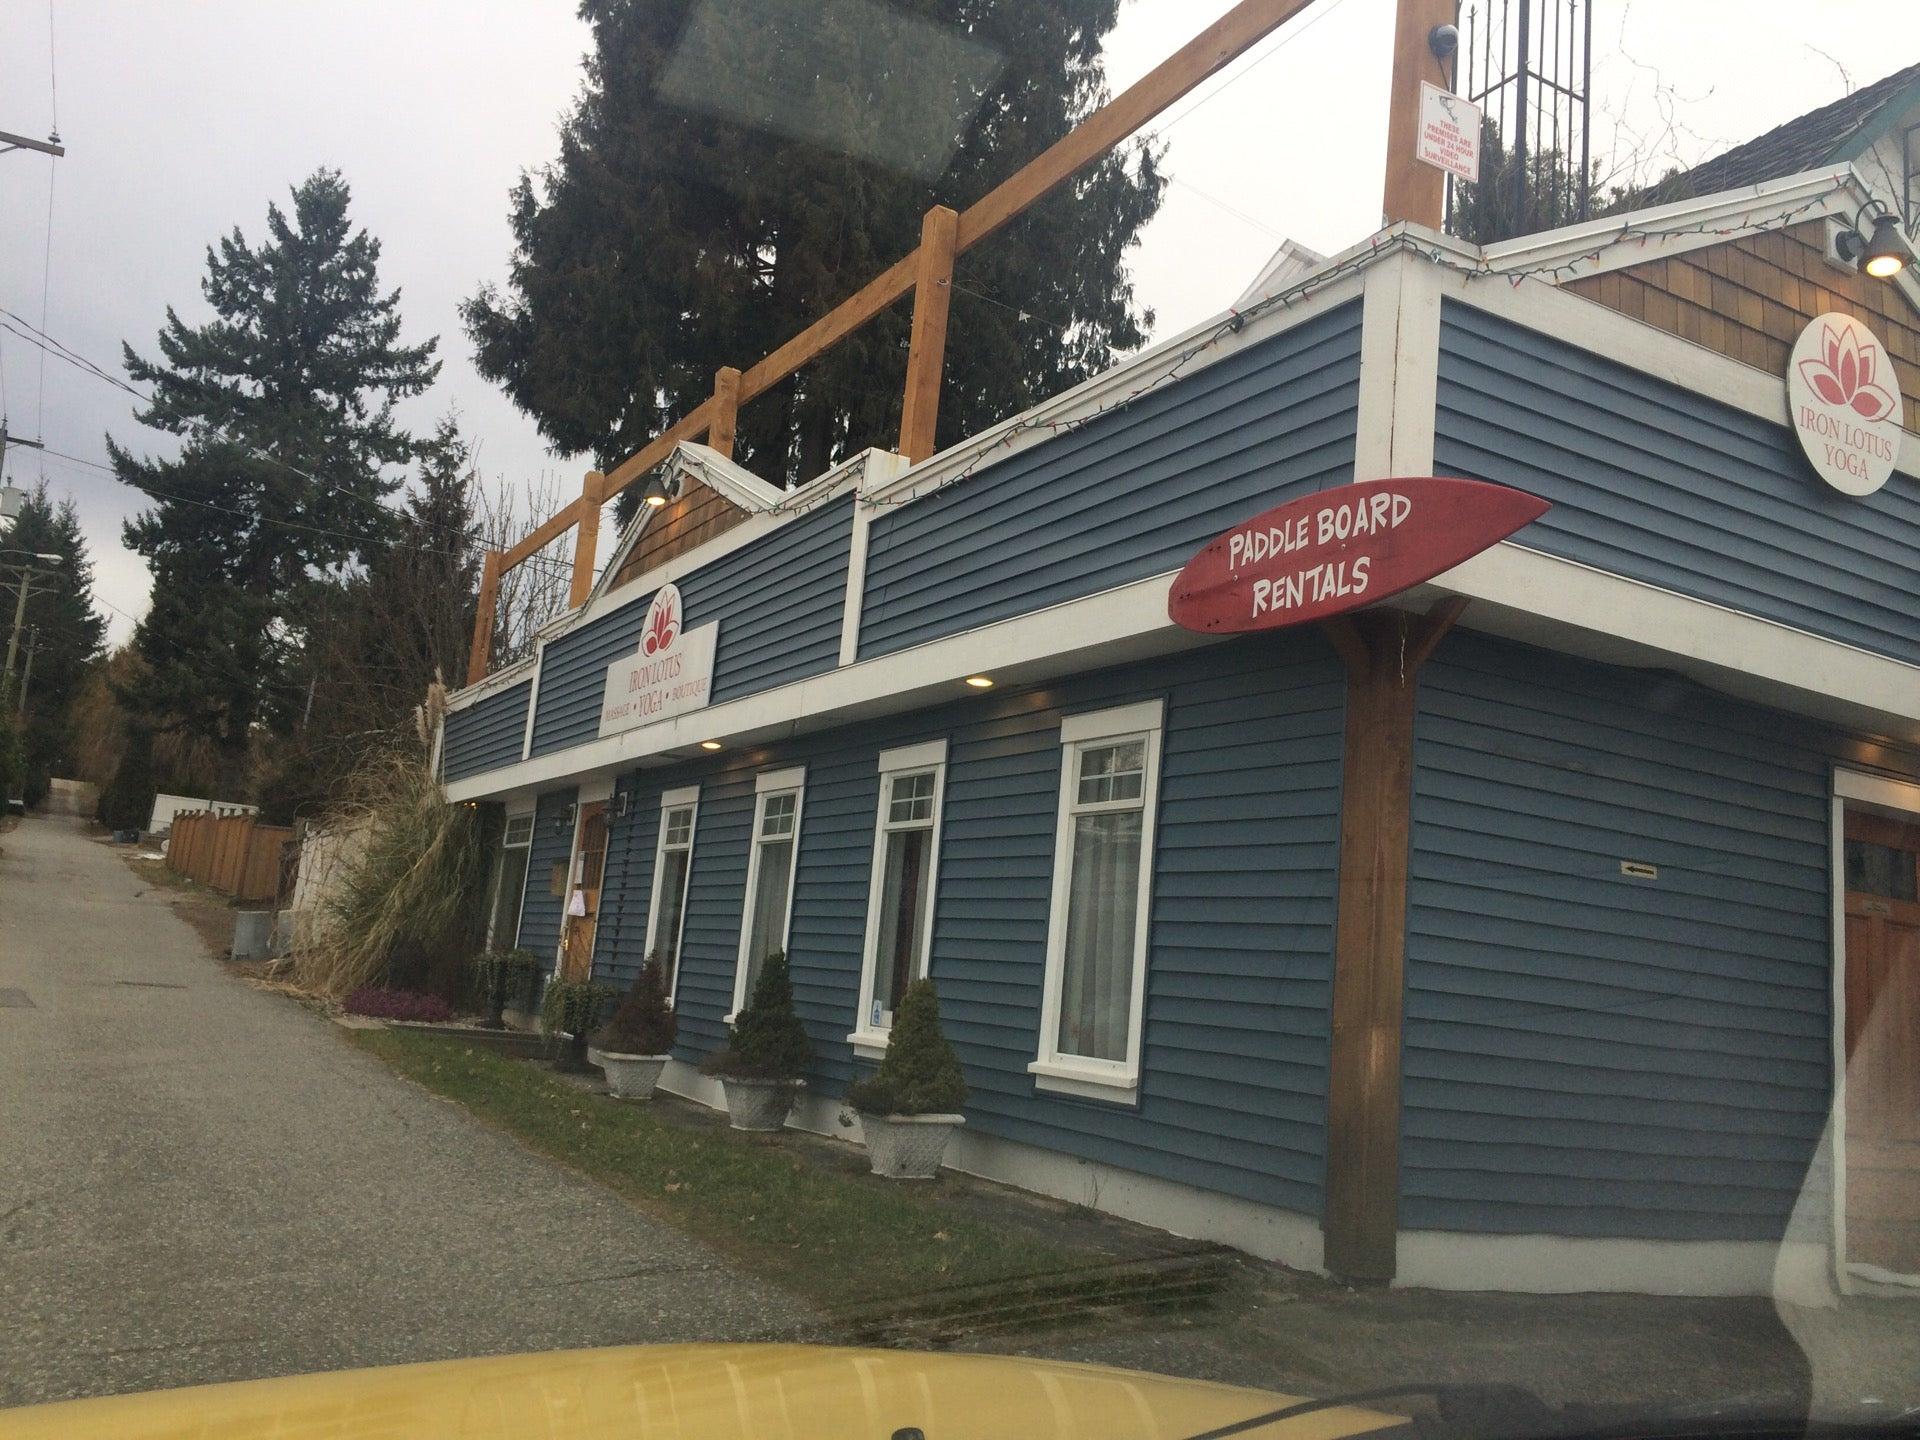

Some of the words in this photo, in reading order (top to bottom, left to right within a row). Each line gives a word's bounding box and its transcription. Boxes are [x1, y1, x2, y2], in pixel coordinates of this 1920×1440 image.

[1424, 132, 1446, 147] UNDER
[1446, 140, 1455, 150] 24
[1455, 144, 1474, 159] HOUR
[1427, 123, 1459, 142] PREMISES
[1459, 137, 1472, 148] ARE
[1440, 120, 1460, 134] THESE
[1424, 150, 1471, 175] SURVEILLANCE
[1440, 147, 1459, 161] VIDEO
[1800, 405, 1840, 441] IRON
[1844, 422, 1892, 462] LOTUS
[1824, 443, 1869, 481] YOGA
[1228, 516, 1309, 571] PADDLE
[1316, 492, 1412, 546] BOARD
[1251, 556, 1371, 619] RENTALS
[628, 664, 651, 694] IRON
[651, 652, 683, 685] LOTUS
[638, 690, 664, 718] YOGA
[671, 677, 708, 701] BOUTIQUE
